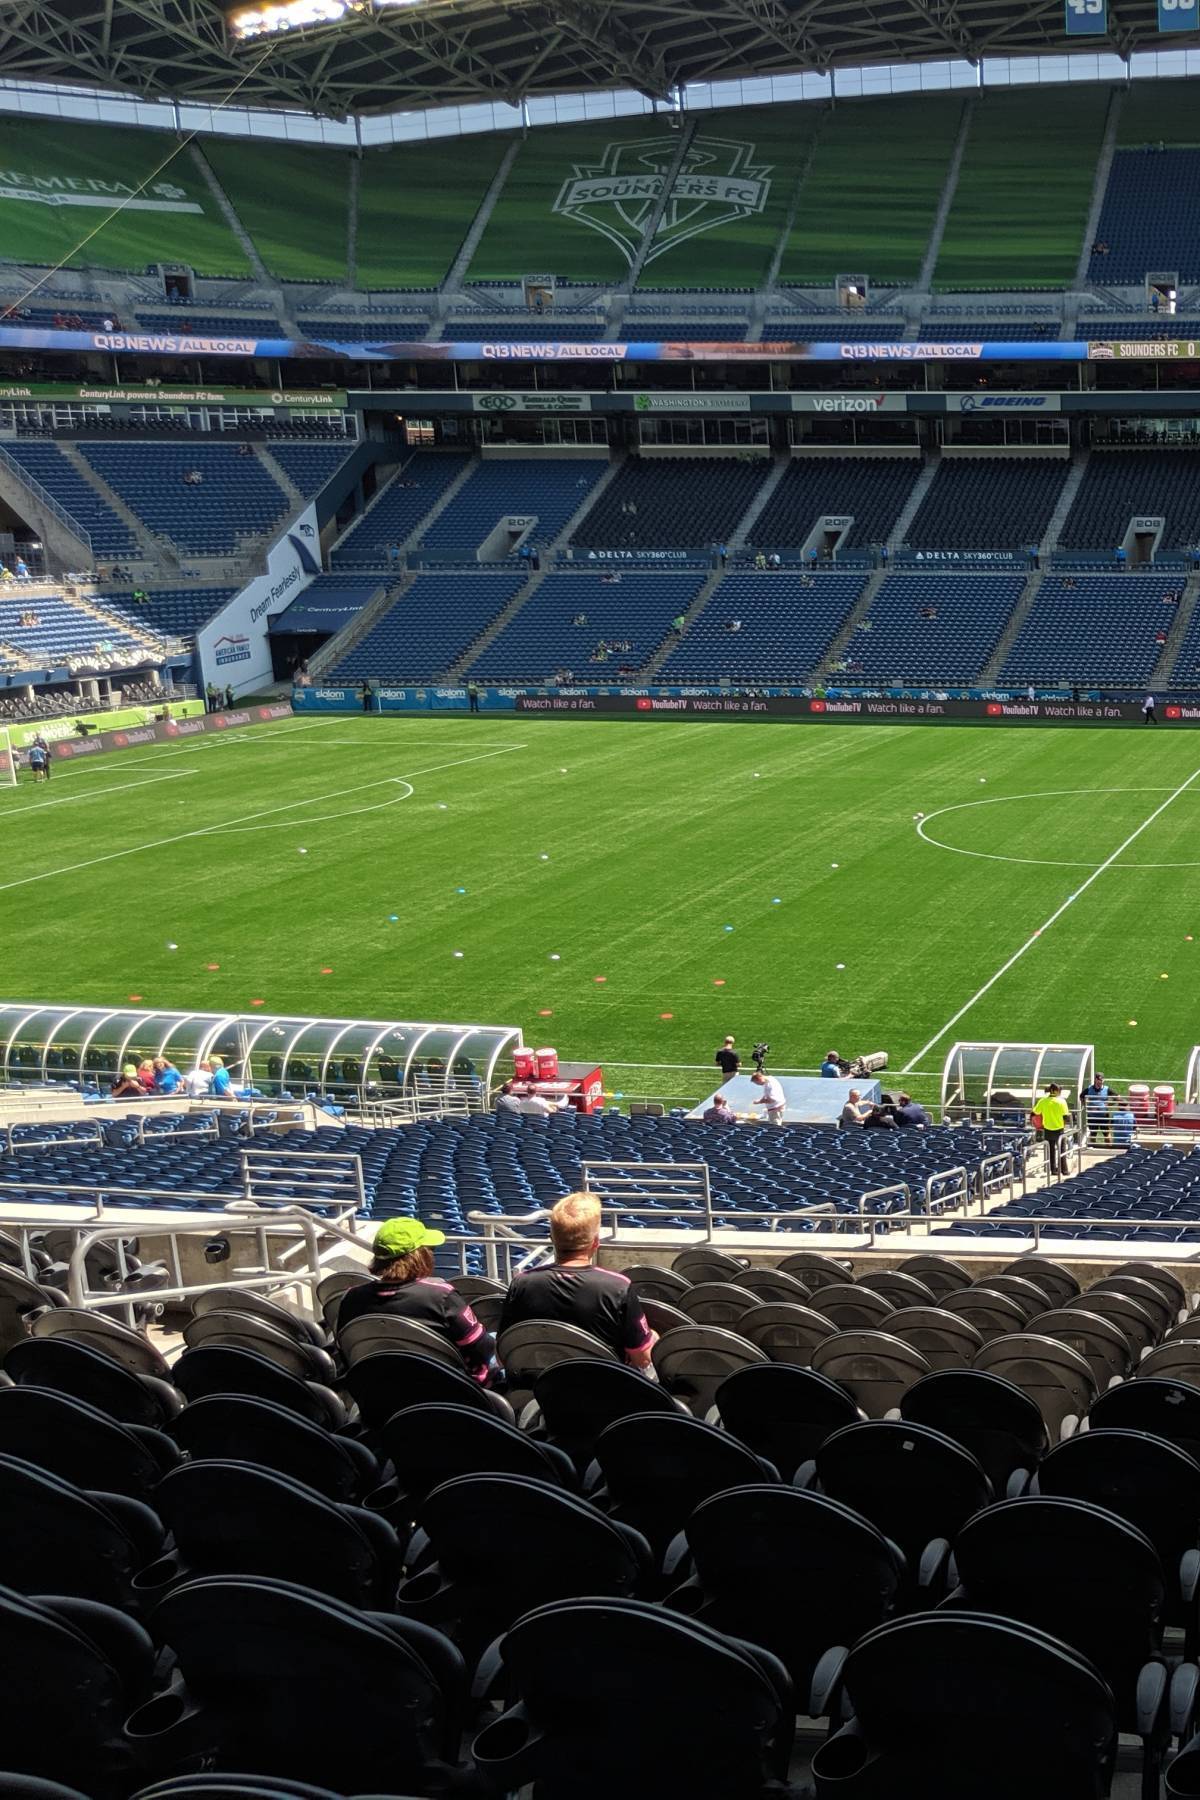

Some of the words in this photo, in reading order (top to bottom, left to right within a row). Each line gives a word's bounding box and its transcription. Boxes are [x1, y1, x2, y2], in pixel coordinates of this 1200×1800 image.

[619, 177, 719, 185] SEATLE
[725, 187, 754, 201] FC
[127, 336, 177, 351] NEWS
[182, 339, 208, 351] ALL
[210, 340, 252, 352] LOCAL
[1120, 343, 1166, 357] SOUNDERS
[1168, 342, 1179, 356] FC
[511, 345, 554, 358] NEWS
[560, 345, 582, 357] ALL
[584, 345, 622, 357] LOCAL
[869, 345, 911, 358] NEWS
[917, 345, 938, 357] ALL
[941, 345, 978, 357] LOCAL
[80, 389, 126, 400] CenturyLink
[127, 392, 157, 401] powers
[158, 391, 195, 400] Sounders
[196, 392, 206, 400] FC
[284, 394, 334, 405] CenturyLink
[650, 399, 705, 408] WASHINGTON
[813, 397, 878, 412] verizon
[981, 396, 1047, 407] BOEING
[600, 551, 633, 559] DELTA
[926, 552, 960, 560] DELTA
[250, 597, 272, 624] Dream
[270, 565, 303, 602] Fearlessly
[523, 699, 551, 709] Watch
[553, 699, 569, 709] like
[579, 699, 596, 709] fan.
[693, 701, 721, 711] Watch
[724, 701, 739, 711] like
[751, 701, 768, 711] fan.
[868, 703, 897, 713] Watch
[900, 703, 915, 713] like
[927, 703, 944, 714] fan.
[1045, 706, 1075, 716] Watch
[1077, 706, 1093, 717] like
[1104, 706, 1122, 717] fan.
